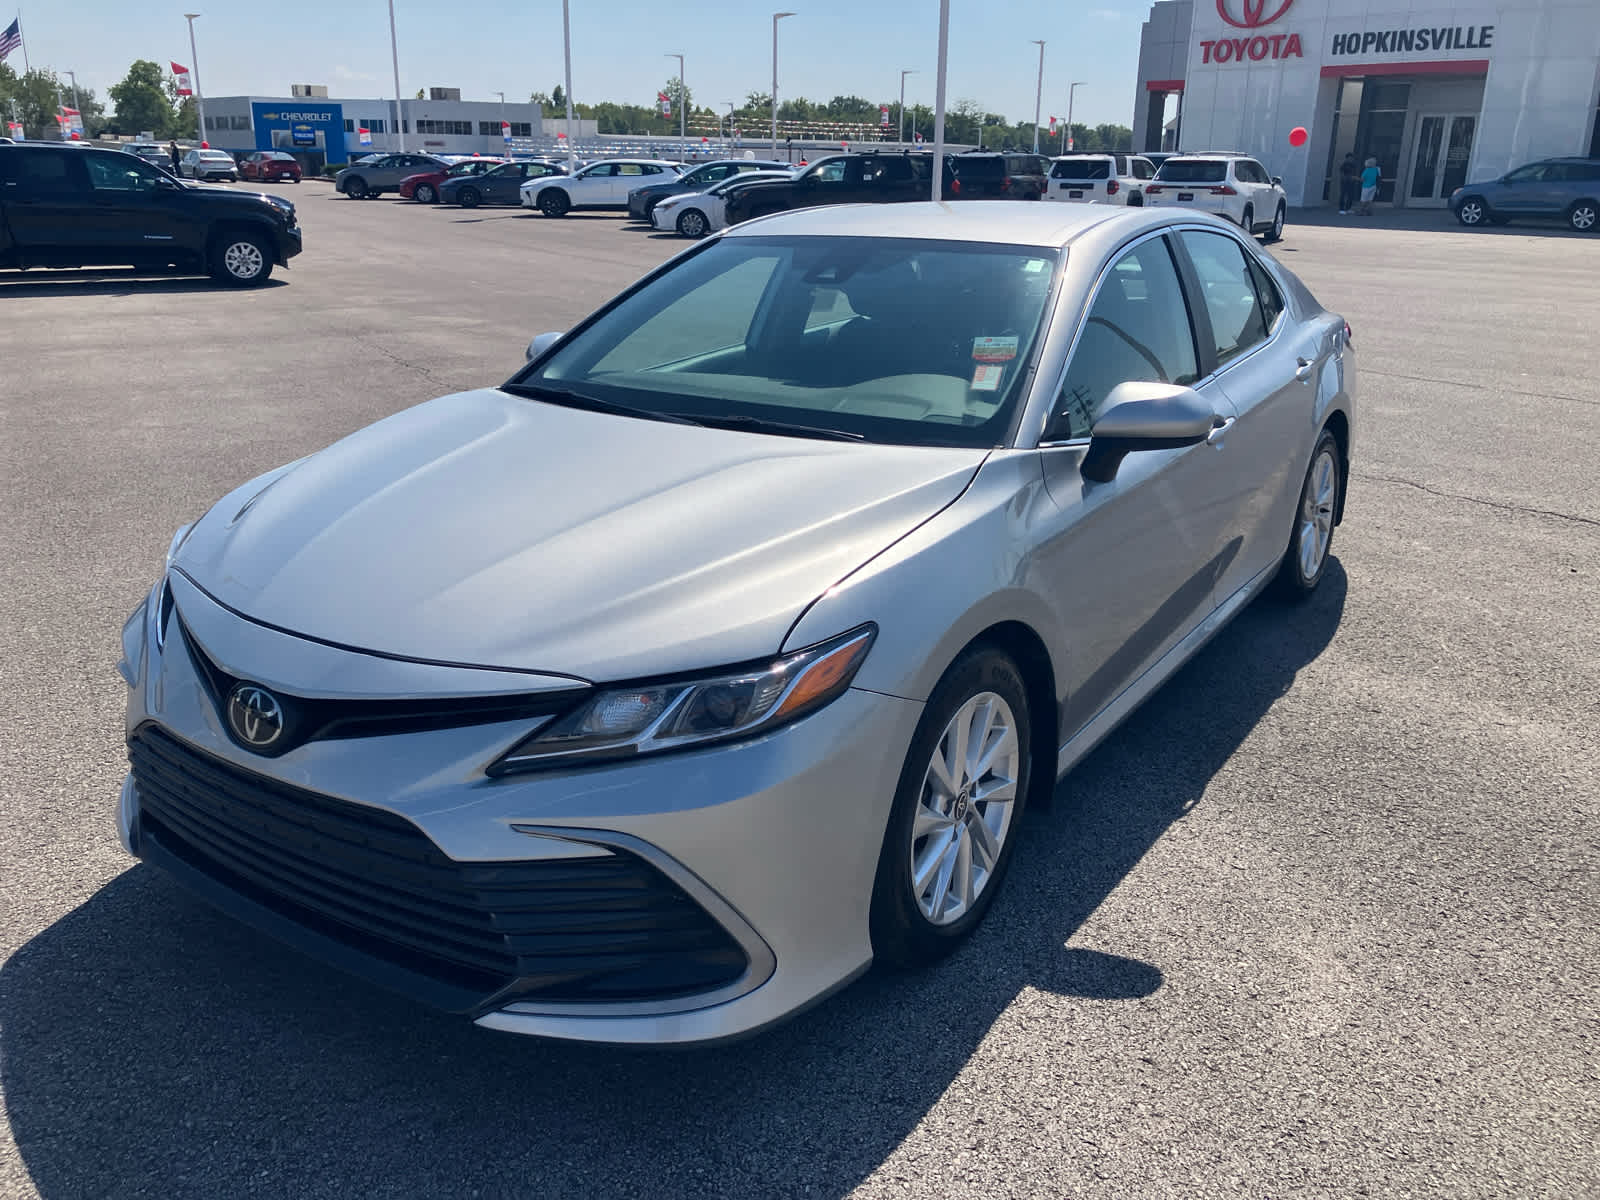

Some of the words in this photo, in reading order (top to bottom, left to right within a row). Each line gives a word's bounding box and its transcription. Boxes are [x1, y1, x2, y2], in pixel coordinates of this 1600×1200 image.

[1200, 33, 1304, 64] TOYOTA
[1332, 25, 1495, 55] HOPKINSVILLE
[281, 112, 332, 121] CHEVROLET
